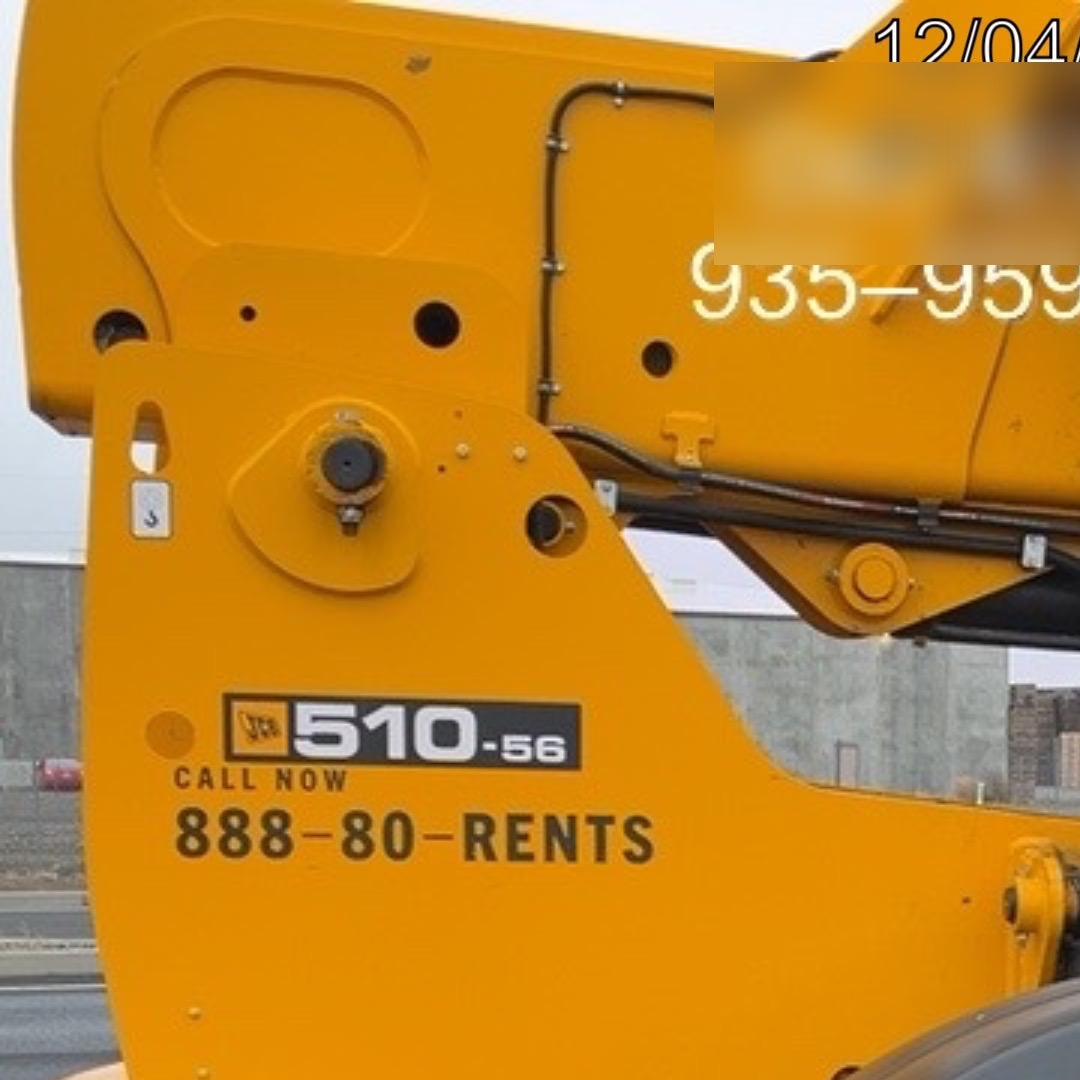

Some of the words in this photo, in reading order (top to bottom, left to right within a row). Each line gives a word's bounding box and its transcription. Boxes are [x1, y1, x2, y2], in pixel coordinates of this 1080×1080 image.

[293, 702, 567, 763] 510-56
[173, 766, 256, 791] CALL
[275, 767, 347, 792] NOW
[176, 806, 655, 865] 888-80-RENTS
